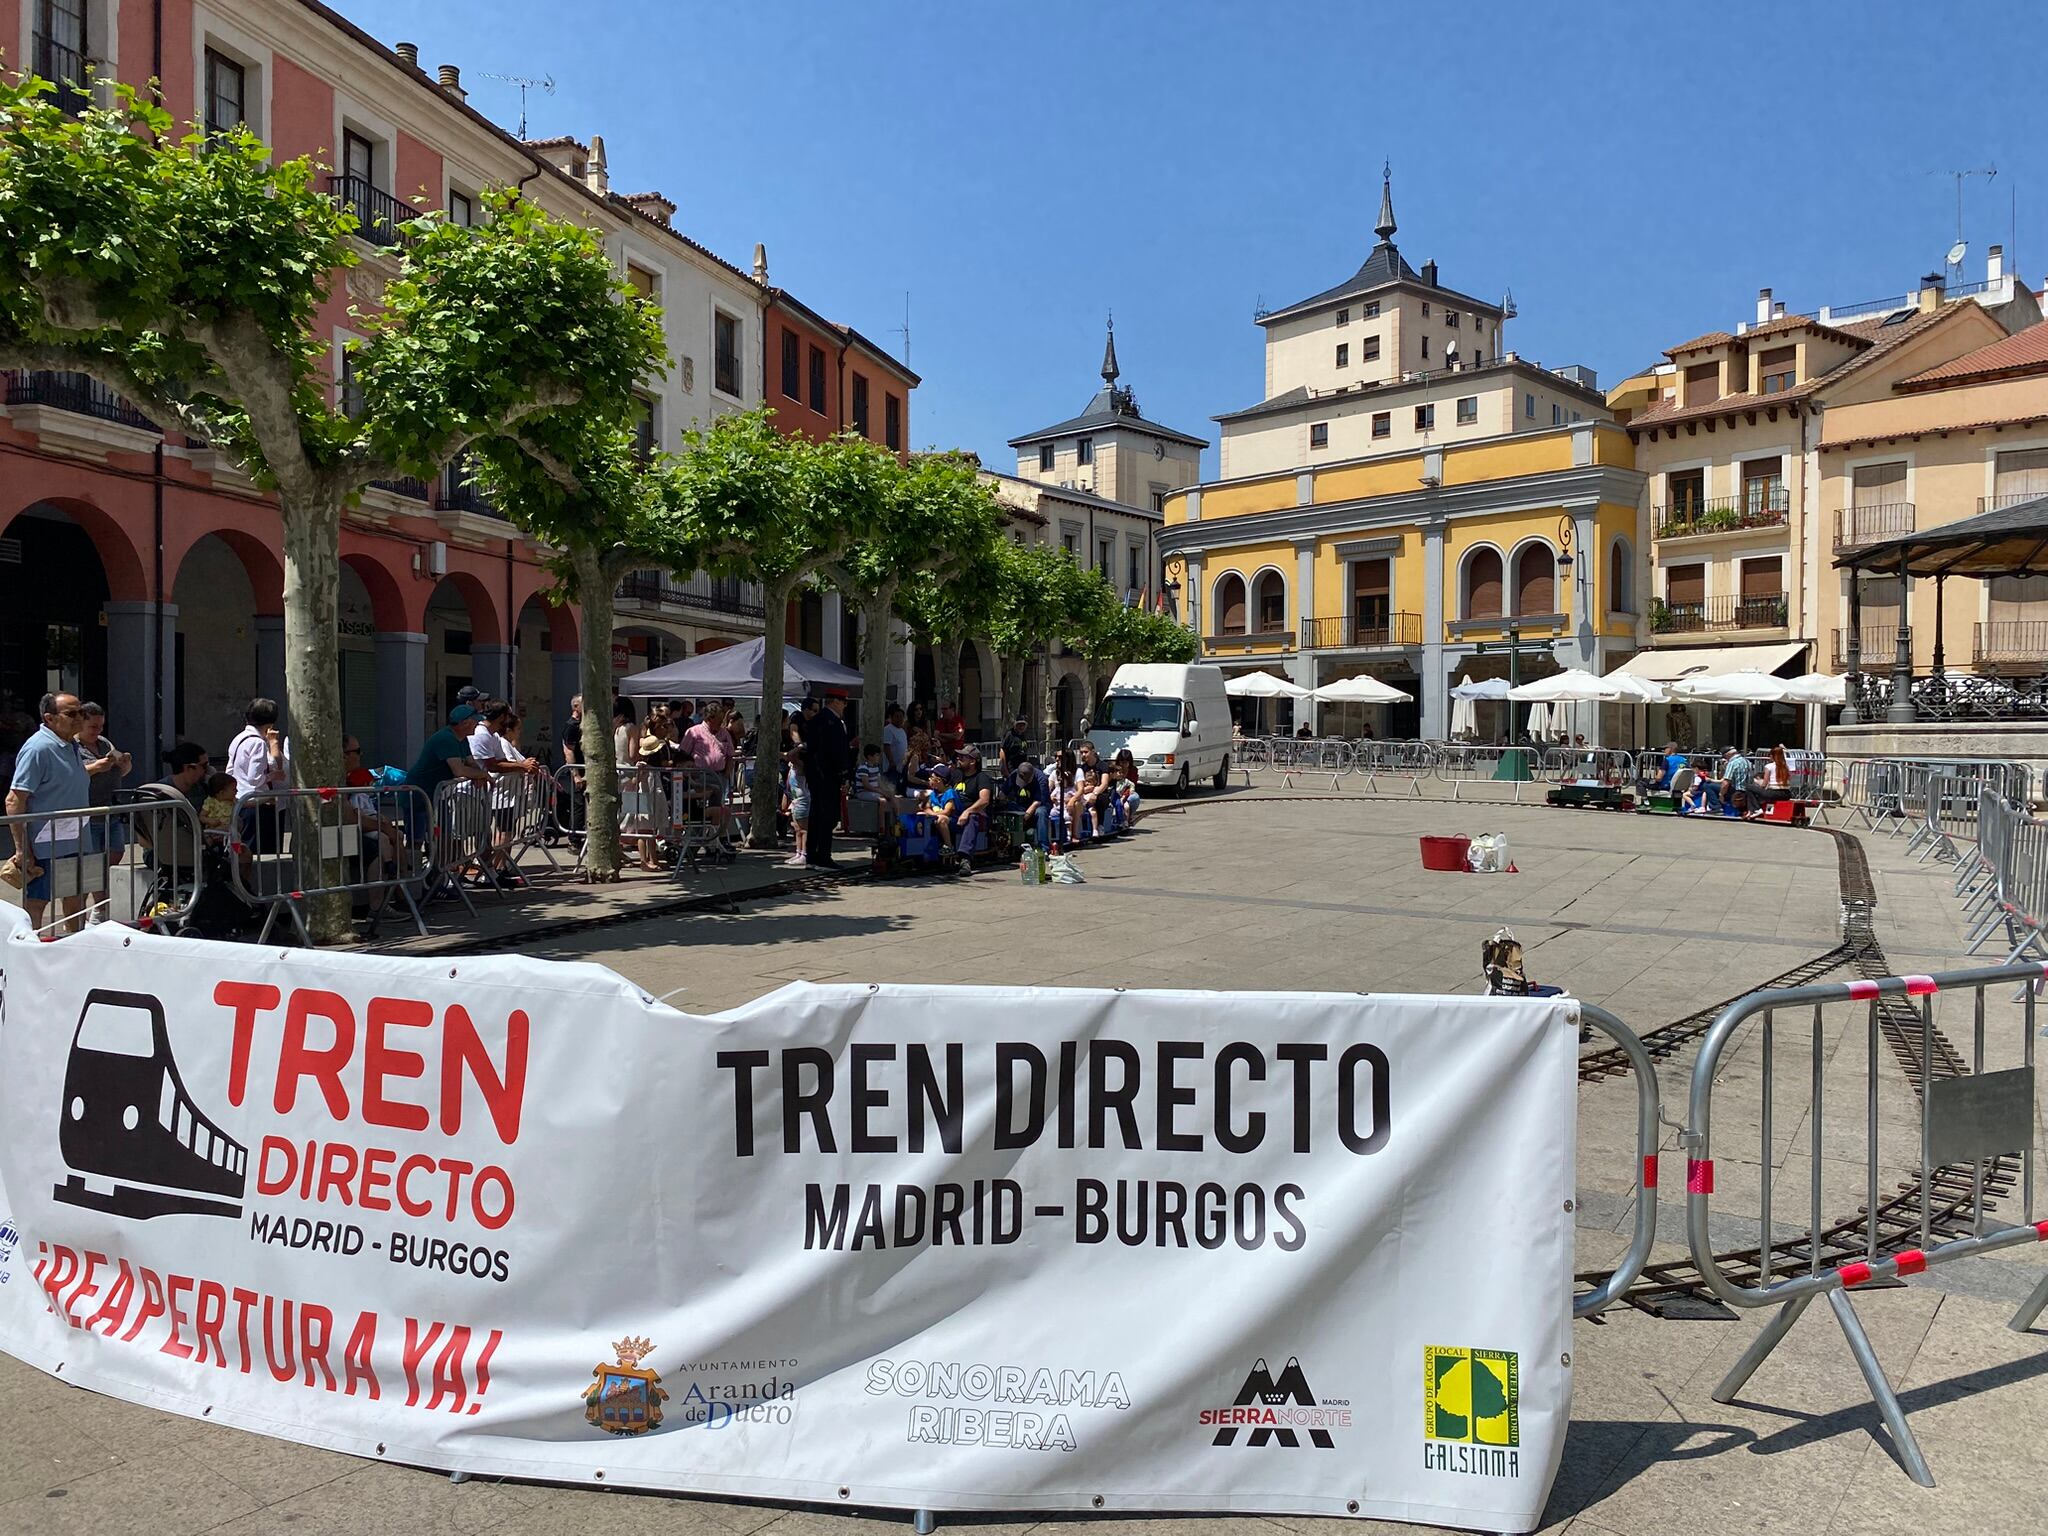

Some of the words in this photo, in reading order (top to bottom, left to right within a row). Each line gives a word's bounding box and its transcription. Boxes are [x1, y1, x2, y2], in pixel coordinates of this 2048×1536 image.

[214, 980, 530, 1145] TREN
[716, 1042, 964, 1157] TREN
[993, 1040, 1391, 1156] DIRECTO
[256, 1135, 515, 1230] DIRECTO
[251, 1211, 364, 1255] MADRID
[389, 1232, 510, 1282] BURGOS
[33, 1241, 381, 1401] ¡REAPERTURA
[403, 1317, 503, 1416] YA!
[679, 1358, 799, 1372] AYUNTAMIENTO
[1435, 1347, 1465, 1356] LOCAL
[1474, 1350, 1507, 1360] SIERRA
[682, 1376, 796, 1405] Aranda
[864, 1359, 1131, 1410] SONORAMA
[1427, 1385, 1434, 1398] DE
[907, 1405, 1077, 1452] RIBERA
[1426, 1400, 1434, 1434] GRUPO
[1510, 1403, 1518, 1443] MADRID
